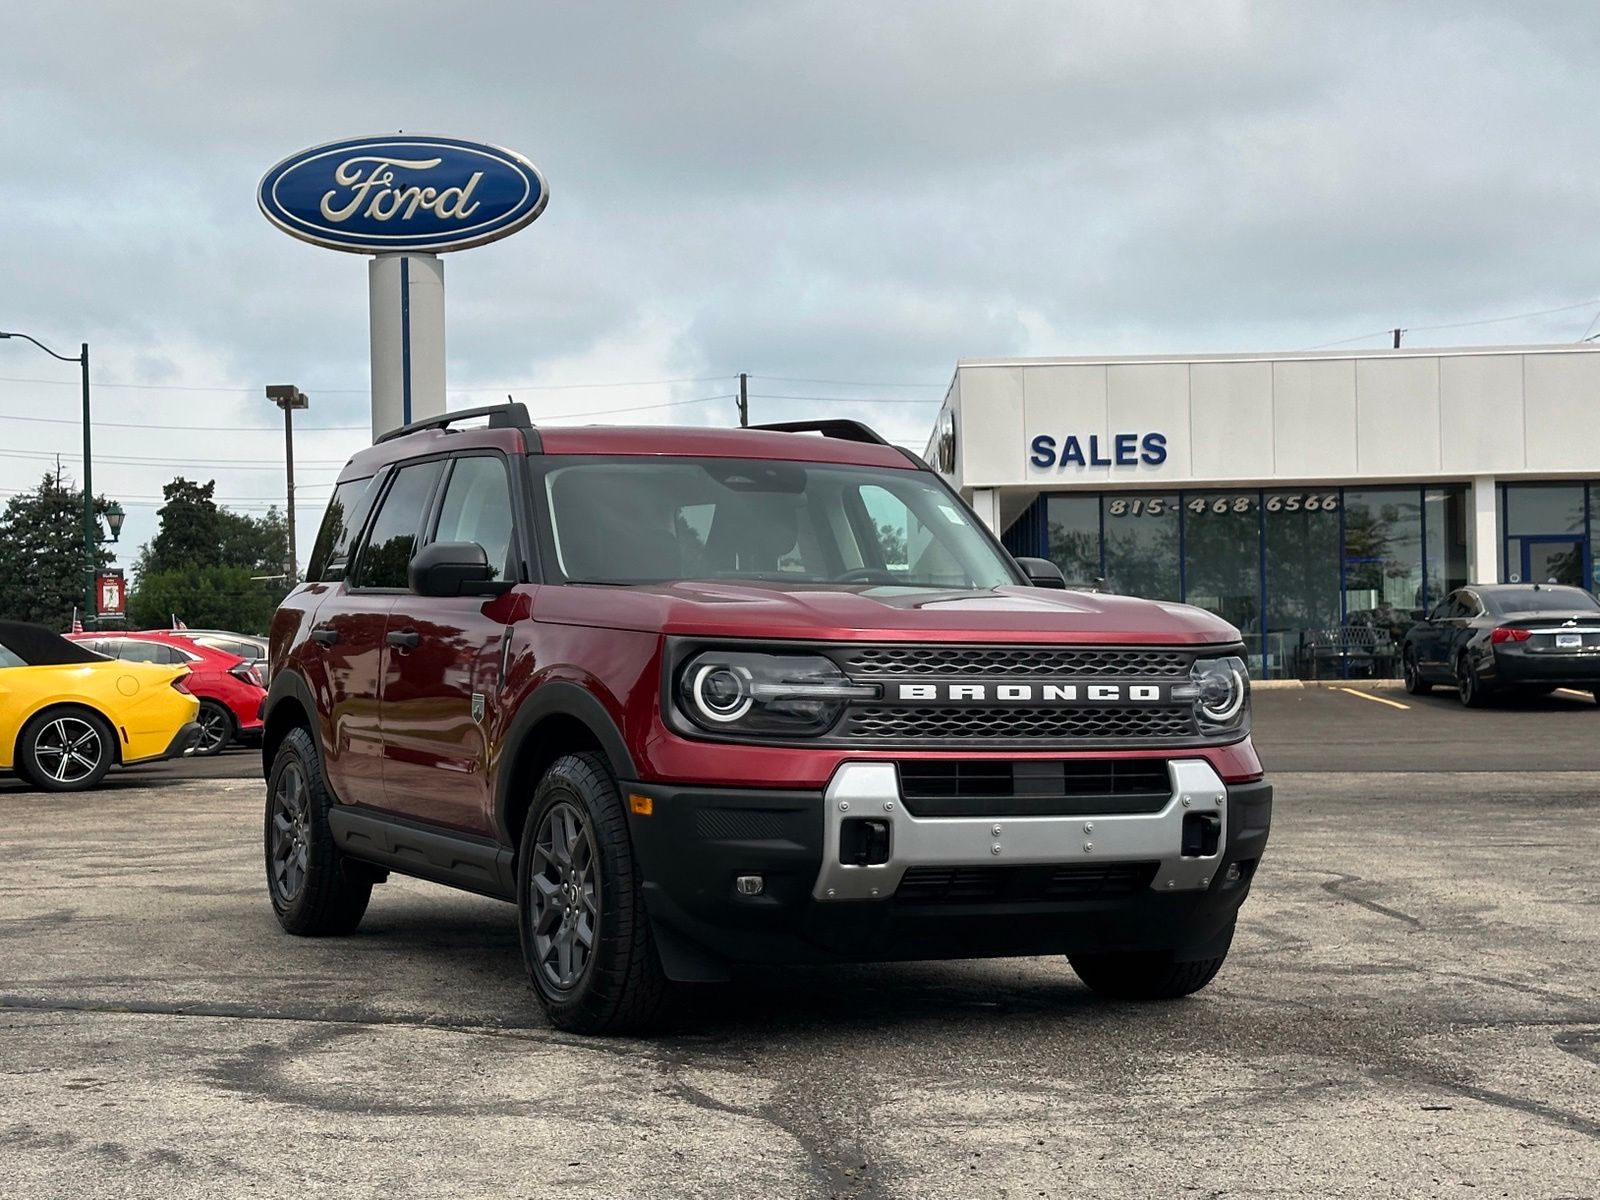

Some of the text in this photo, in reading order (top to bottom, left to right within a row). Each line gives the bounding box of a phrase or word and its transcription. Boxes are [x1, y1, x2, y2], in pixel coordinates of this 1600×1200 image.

[320, 156, 484, 222] Ford
[1030, 432, 1167, 468] SALES
[899, 684, 1161, 701] BRONCO
